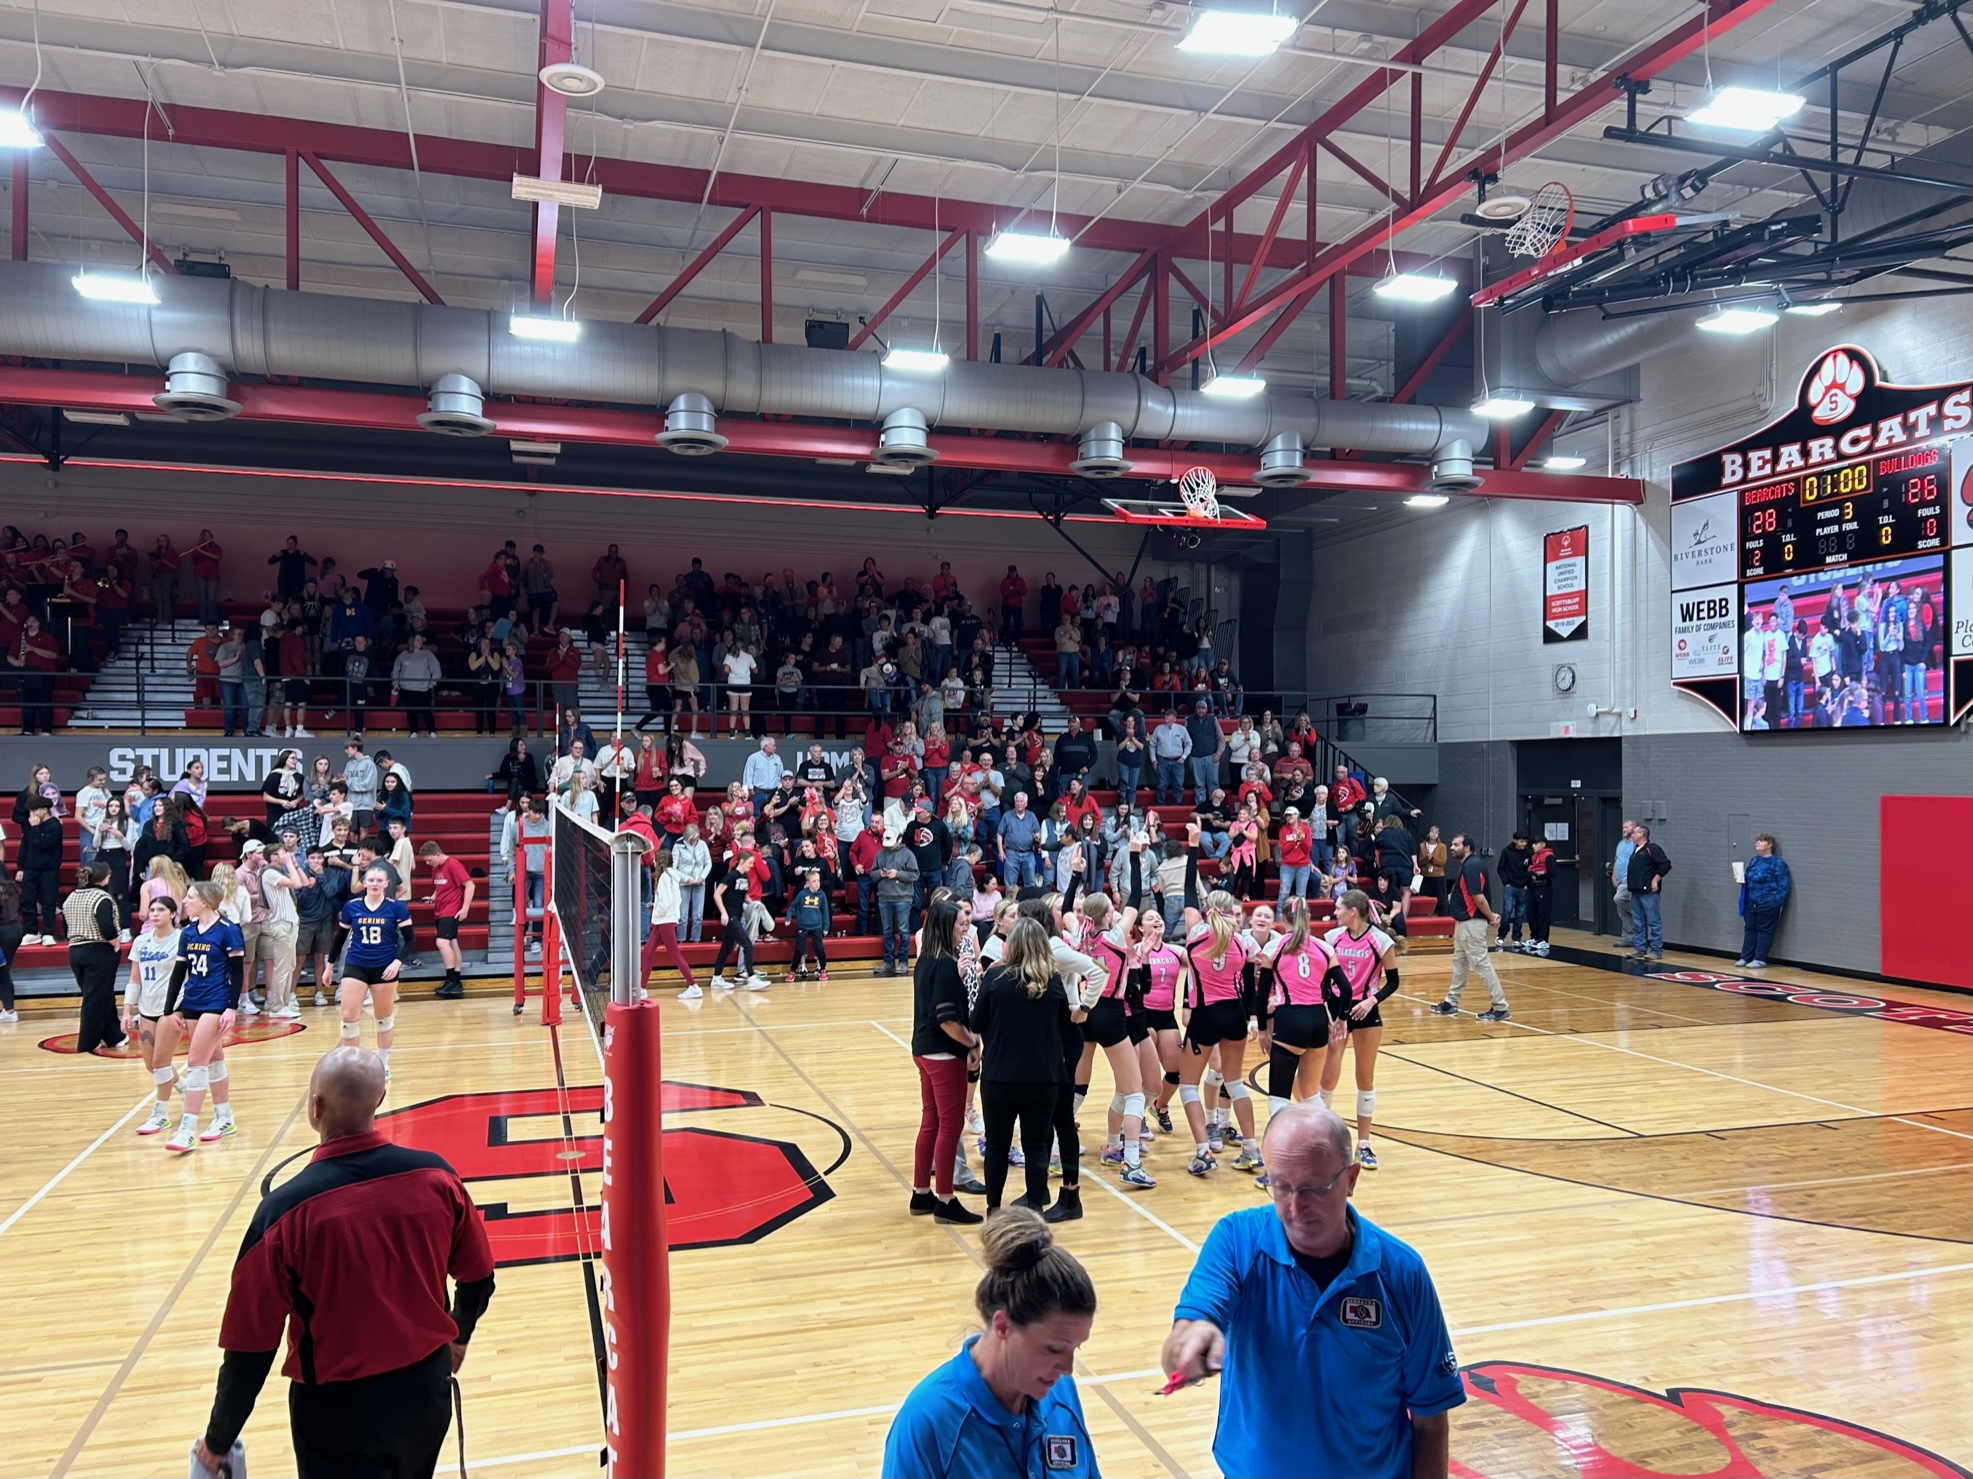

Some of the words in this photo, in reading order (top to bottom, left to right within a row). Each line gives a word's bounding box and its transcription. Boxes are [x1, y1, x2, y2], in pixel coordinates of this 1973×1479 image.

[1721, 386, 1973, 487] BEARCATS
[1879, 449, 1939, 476] BULLDOGS
[1805, 465, 1867, 500] 01:00
[1908, 474, 1937, 503] 26
[1744, 482, 1795, 506] BEARCATS
[1817, 508, 1840, 520] PERIOD
[1844, 501, 1853, 519] 3
[1917, 505, 1940, 517] FOULS
[1753, 508, 1777, 534] 28
[1815, 525, 1839, 536] PLAYER
[1842, 521, 1859, 532] FOUL
[1926, 518, 1937, 536] 0
[1881, 526, 1892, 544] 0
[1746, 539, 1764, 550] FOULS
[1917, 538, 1941, 549] SCORE
[1673, 543, 1736, 562] RIVERSTONE
[1753, 550, 1761, 566] 2
[1784, 543, 1793, 561] 0
[1825, 553, 1848, 564] MATCH
[1555, 562, 1577, 571] NATIONAL
[1696, 558, 1713, 567] BANK
[1746, 566, 1764, 577] SCORE
[1554, 575, 1578, 585] CHAMPION
[1557, 583, 1575, 591] SCHOOL
[1679, 597, 1730, 623] WEBB
[1674, 624, 1695, 635] FAMILY
[1695, 622, 1702, 633] OF
[1703, 620, 1736, 632] COMPANIES
[1961, 634, 1973, 648] C
[360, 926, 382, 944] 18
[1149, 956, 1177, 965] EARCATS
[1337, 947, 1369, 959] BEARCATS
[187, 953, 208, 977] 24
[1297, 952, 1311, 979] 8
[1348, 960, 1356, 977] 5
[144, 966, 156, 981] 11
[1158, 967, 1166, 982] 7
[1645, 971, 1973, 1034] SCOT
